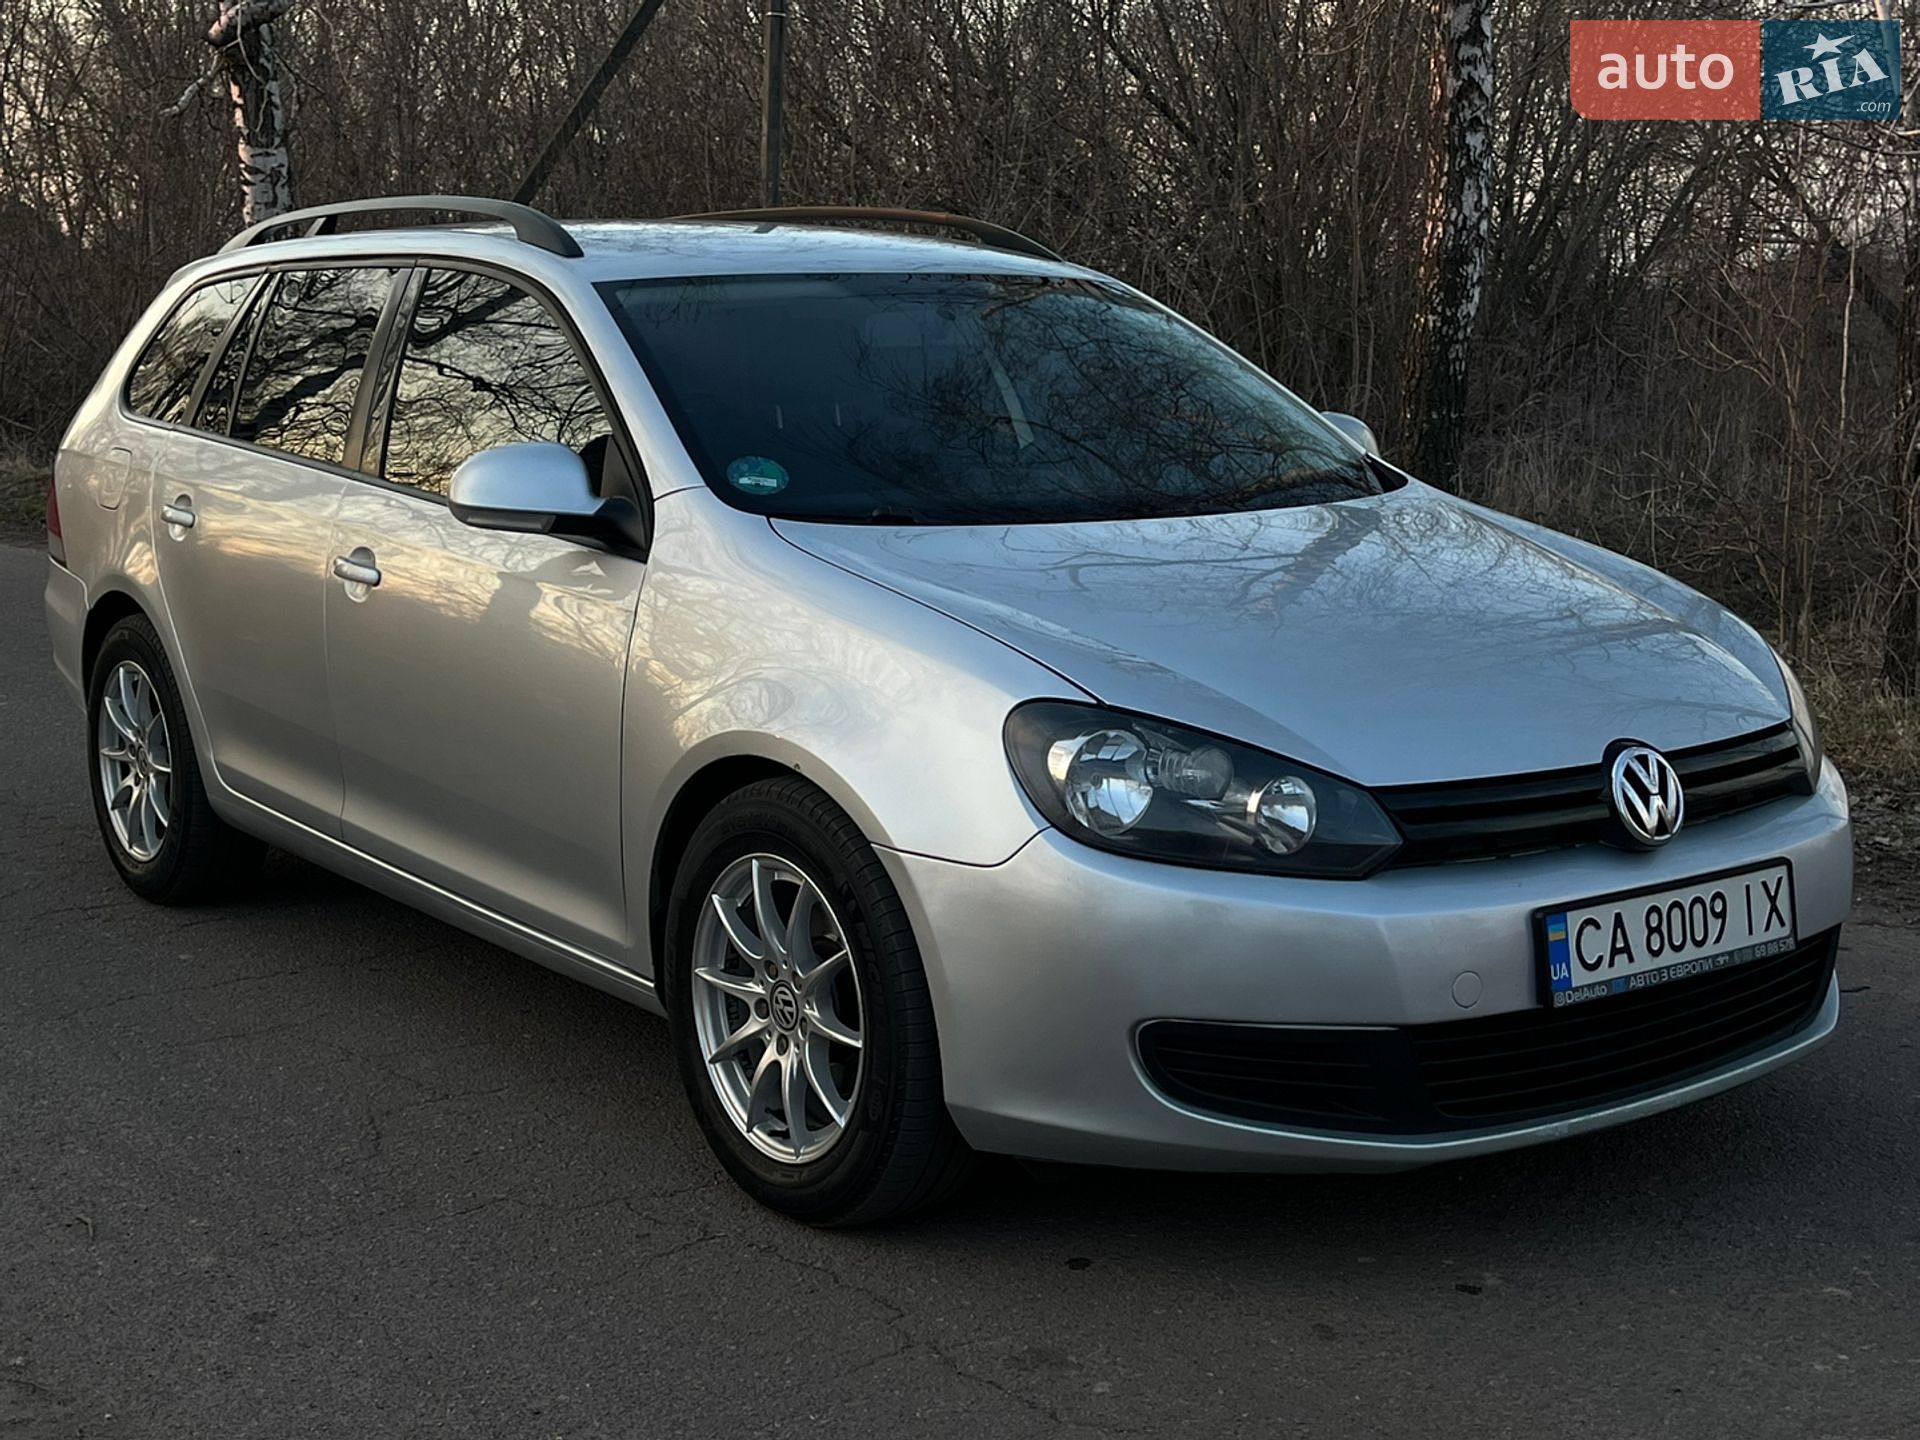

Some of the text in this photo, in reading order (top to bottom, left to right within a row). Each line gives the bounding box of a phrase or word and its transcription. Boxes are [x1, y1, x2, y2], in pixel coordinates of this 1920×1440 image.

[1611, 747, 1684, 841] VW
[1575, 875, 1786, 972] CA 8009 IX
[1550, 961, 1569, 981] UA
